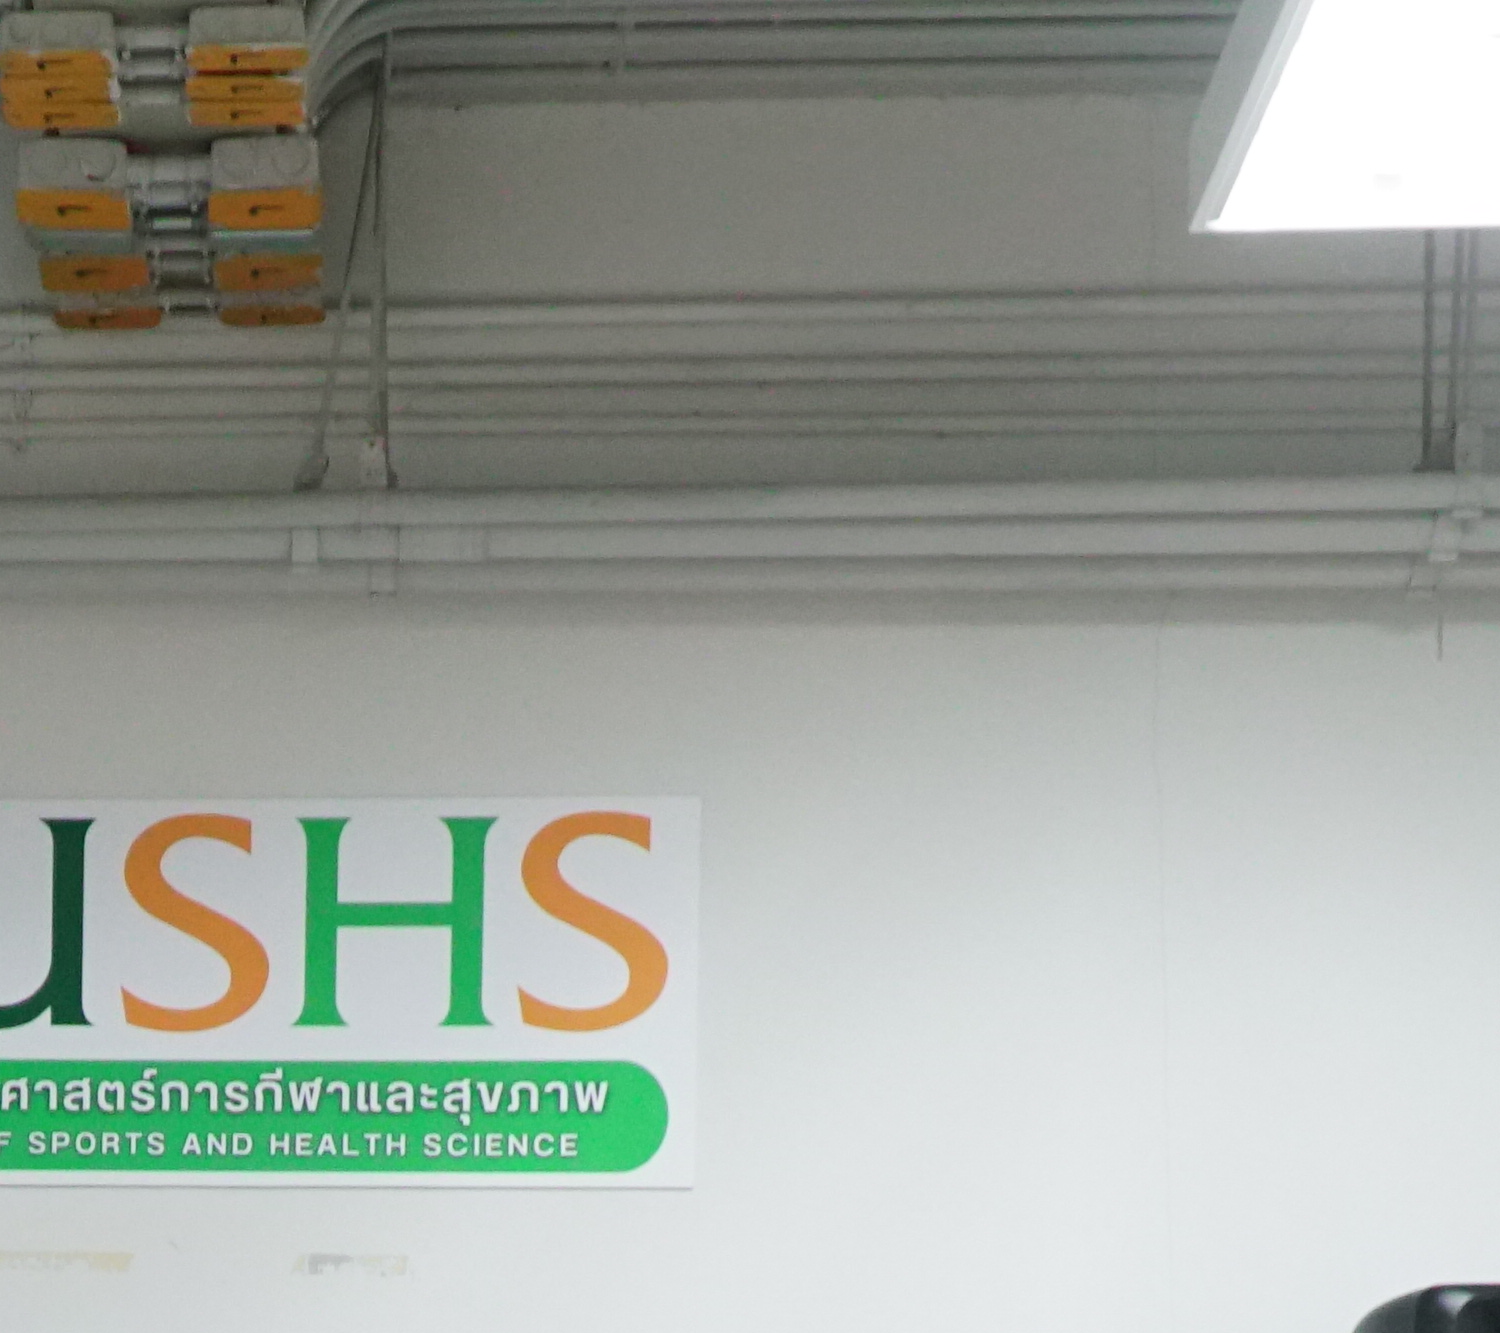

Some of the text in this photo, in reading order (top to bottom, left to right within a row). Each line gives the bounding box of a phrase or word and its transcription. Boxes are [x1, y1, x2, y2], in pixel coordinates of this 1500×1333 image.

[27, 1130, 166, 1156] SPORTS
[182, 1131, 253, 1156] AND
[269, 1131, 407, 1157] HEALTH
[422, 1132, 579, 1158] SCIENCE
